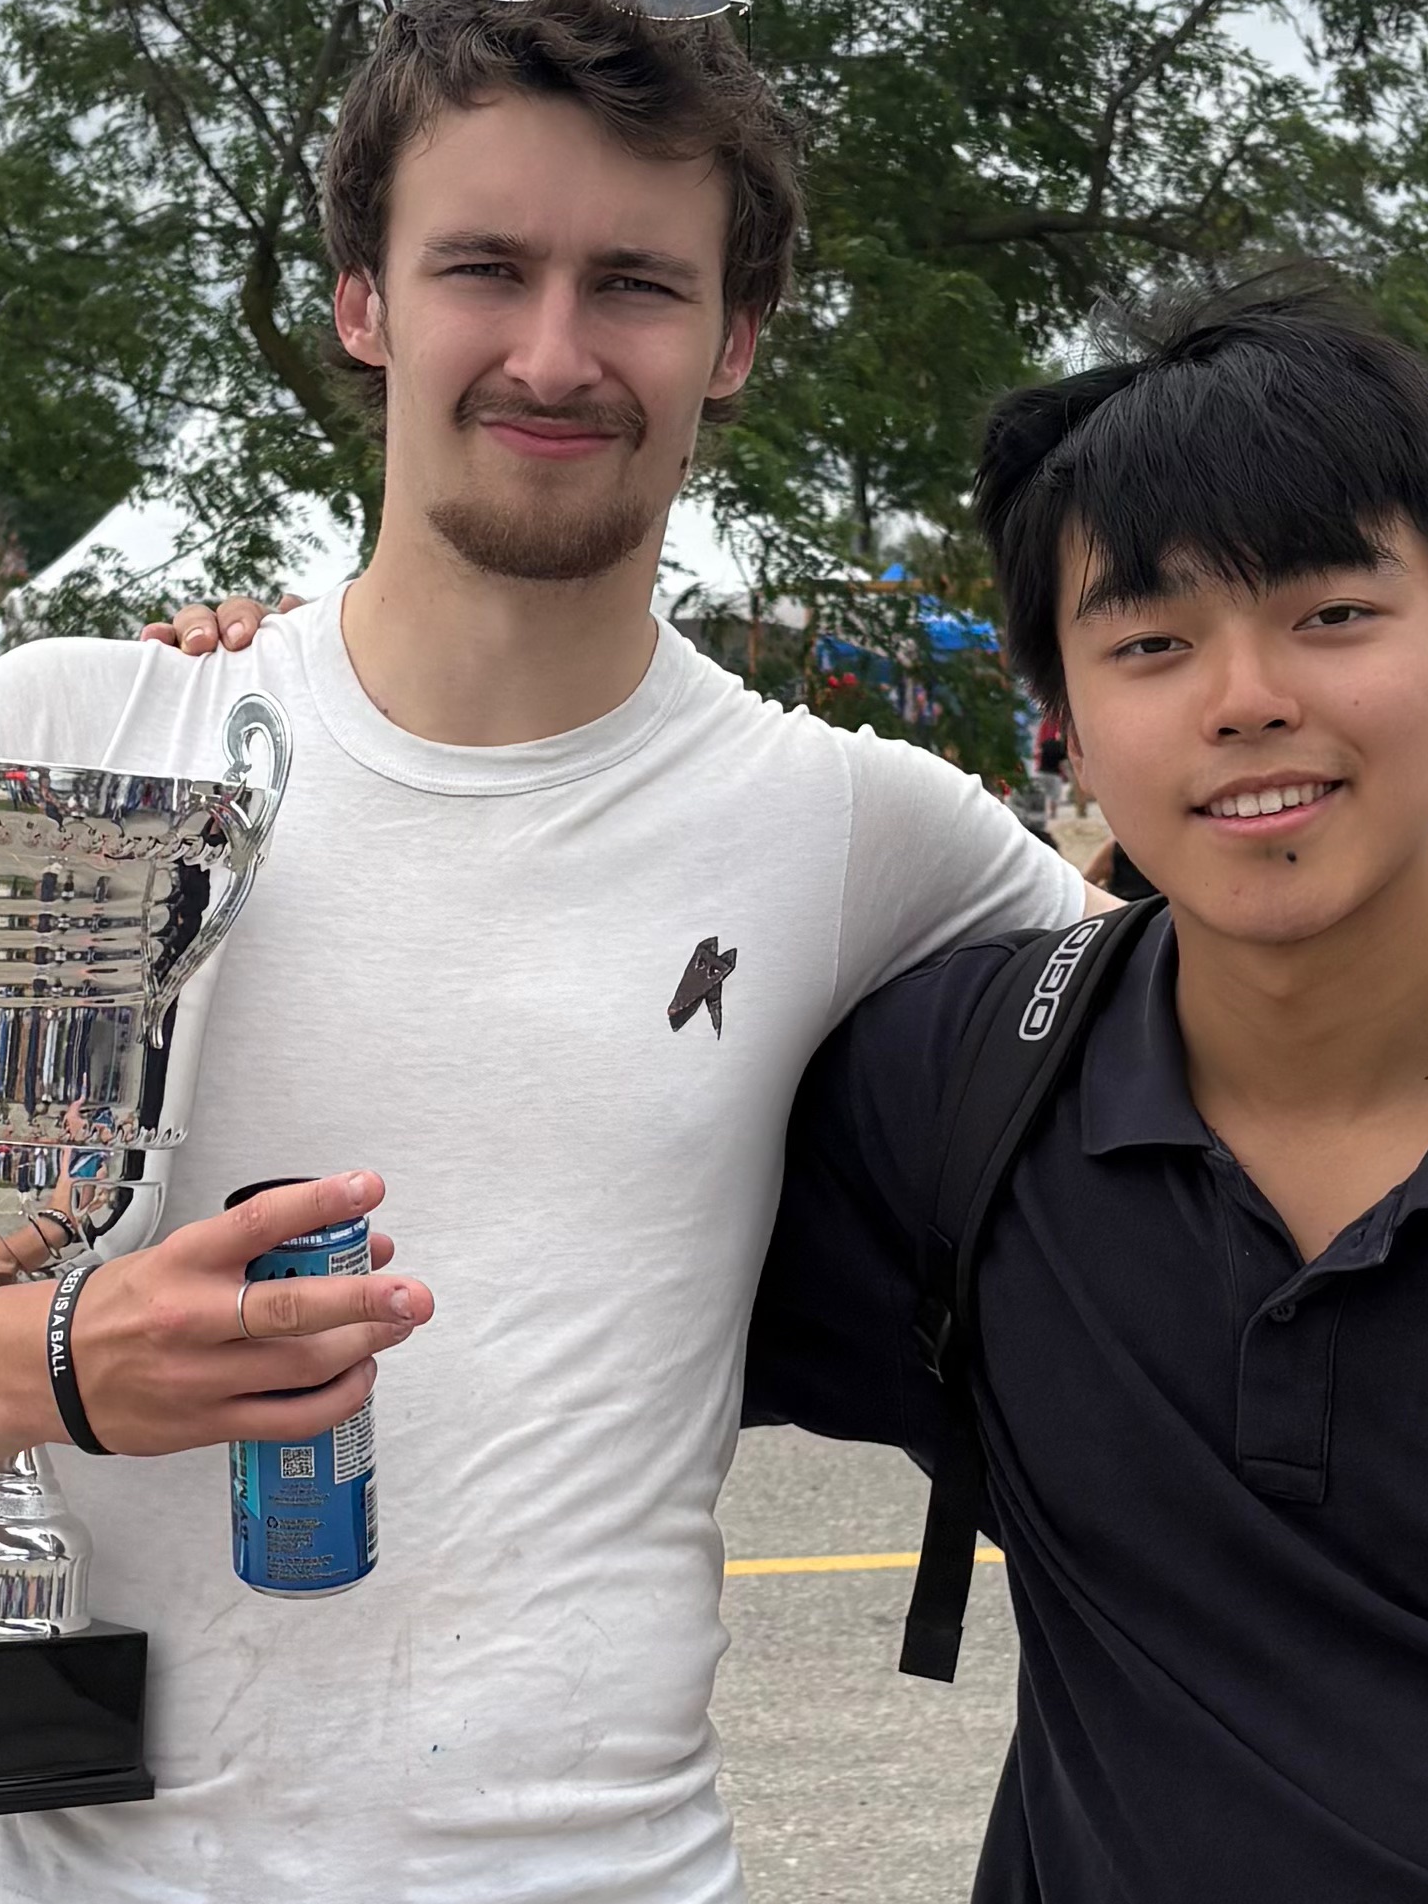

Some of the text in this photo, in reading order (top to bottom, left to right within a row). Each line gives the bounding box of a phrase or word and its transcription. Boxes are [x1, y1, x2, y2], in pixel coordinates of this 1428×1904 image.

[1018, 919, 1105, 1041] OGIO
[54, 1296, 71, 1311] IS
[52, 1314, 66, 1327] A
[50, 1330, 67, 1378] BALL
